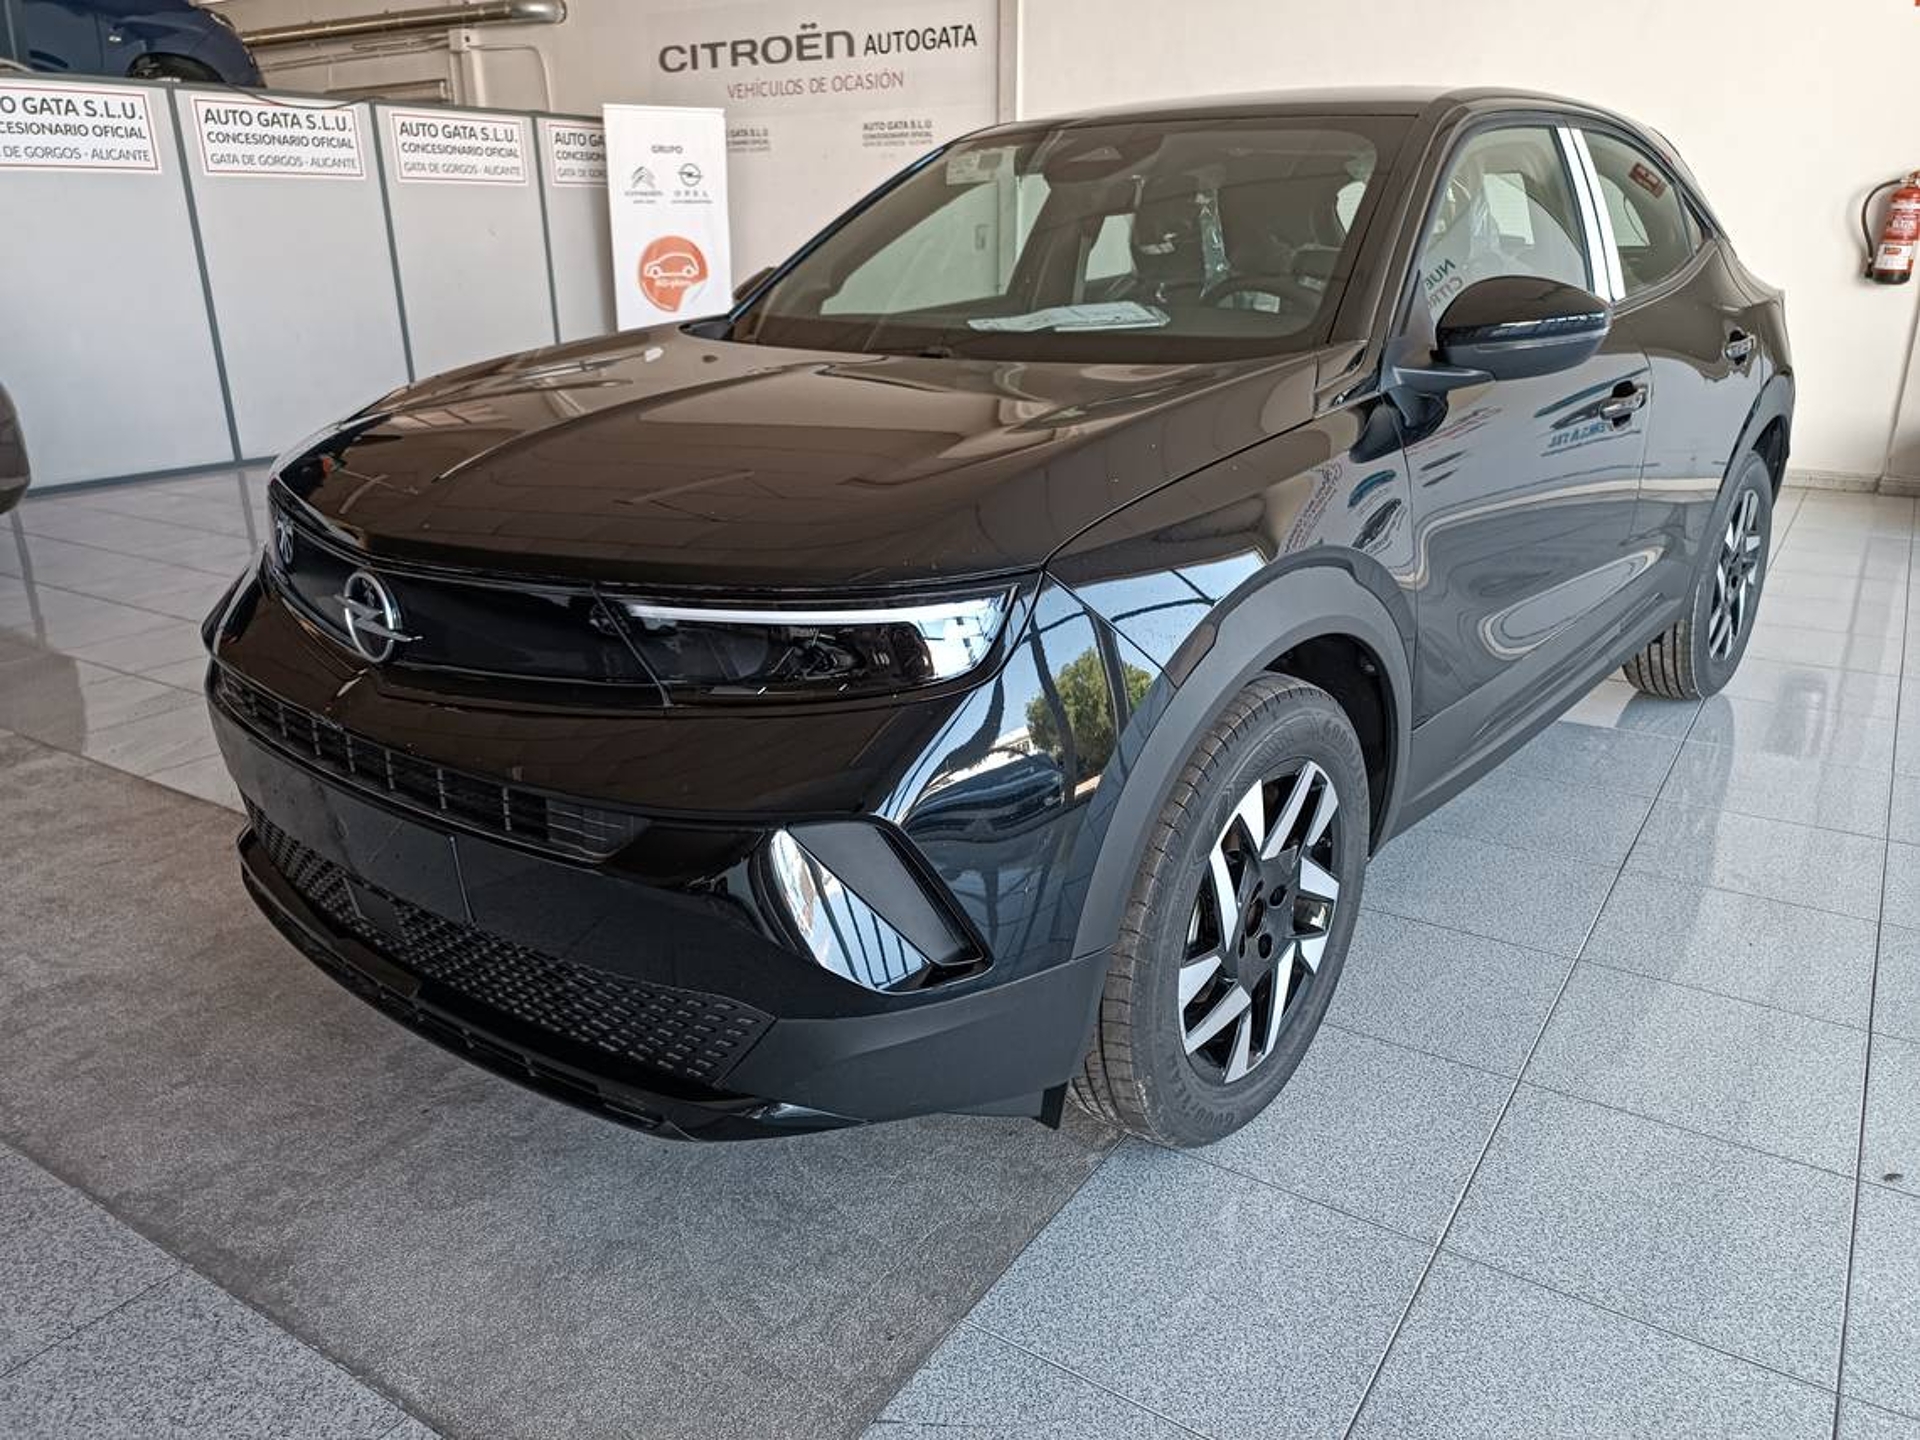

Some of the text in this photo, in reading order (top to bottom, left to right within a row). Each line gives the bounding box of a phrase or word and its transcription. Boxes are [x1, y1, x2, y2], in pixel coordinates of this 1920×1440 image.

[864, 24, 978, 57] AUTOGATA
[727, 70, 904, 99] VEHÍCULOS DE OCASIÓN
[22, 97, 80, 117] GATA
[84, 100, 143, 120] S.L.U.
[204, 108, 352, 132] AUTO GATA S.L.U.
[92, 124, 147, 139] OFICIAL
[206, 131, 354, 149] CONCESIONARIO OFICIAL
[399, 121, 518, 143] AUTO GATA S.L.U.
[554, 132, 587, 147] AUTO
[3, 146, 21, 158] DE
[24, 146, 82, 160] GORGOS
[91, 149, 150, 162] ALICANTE
[401, 142, 520, 158] CONCESIONARIO OFICIAL
[210, 152, 239, 165] GATA
[242, 154, 256, 166] DE
[258, 155, 304, 168] GORGOS
[310, 156, 358, 169] ALICANTE
